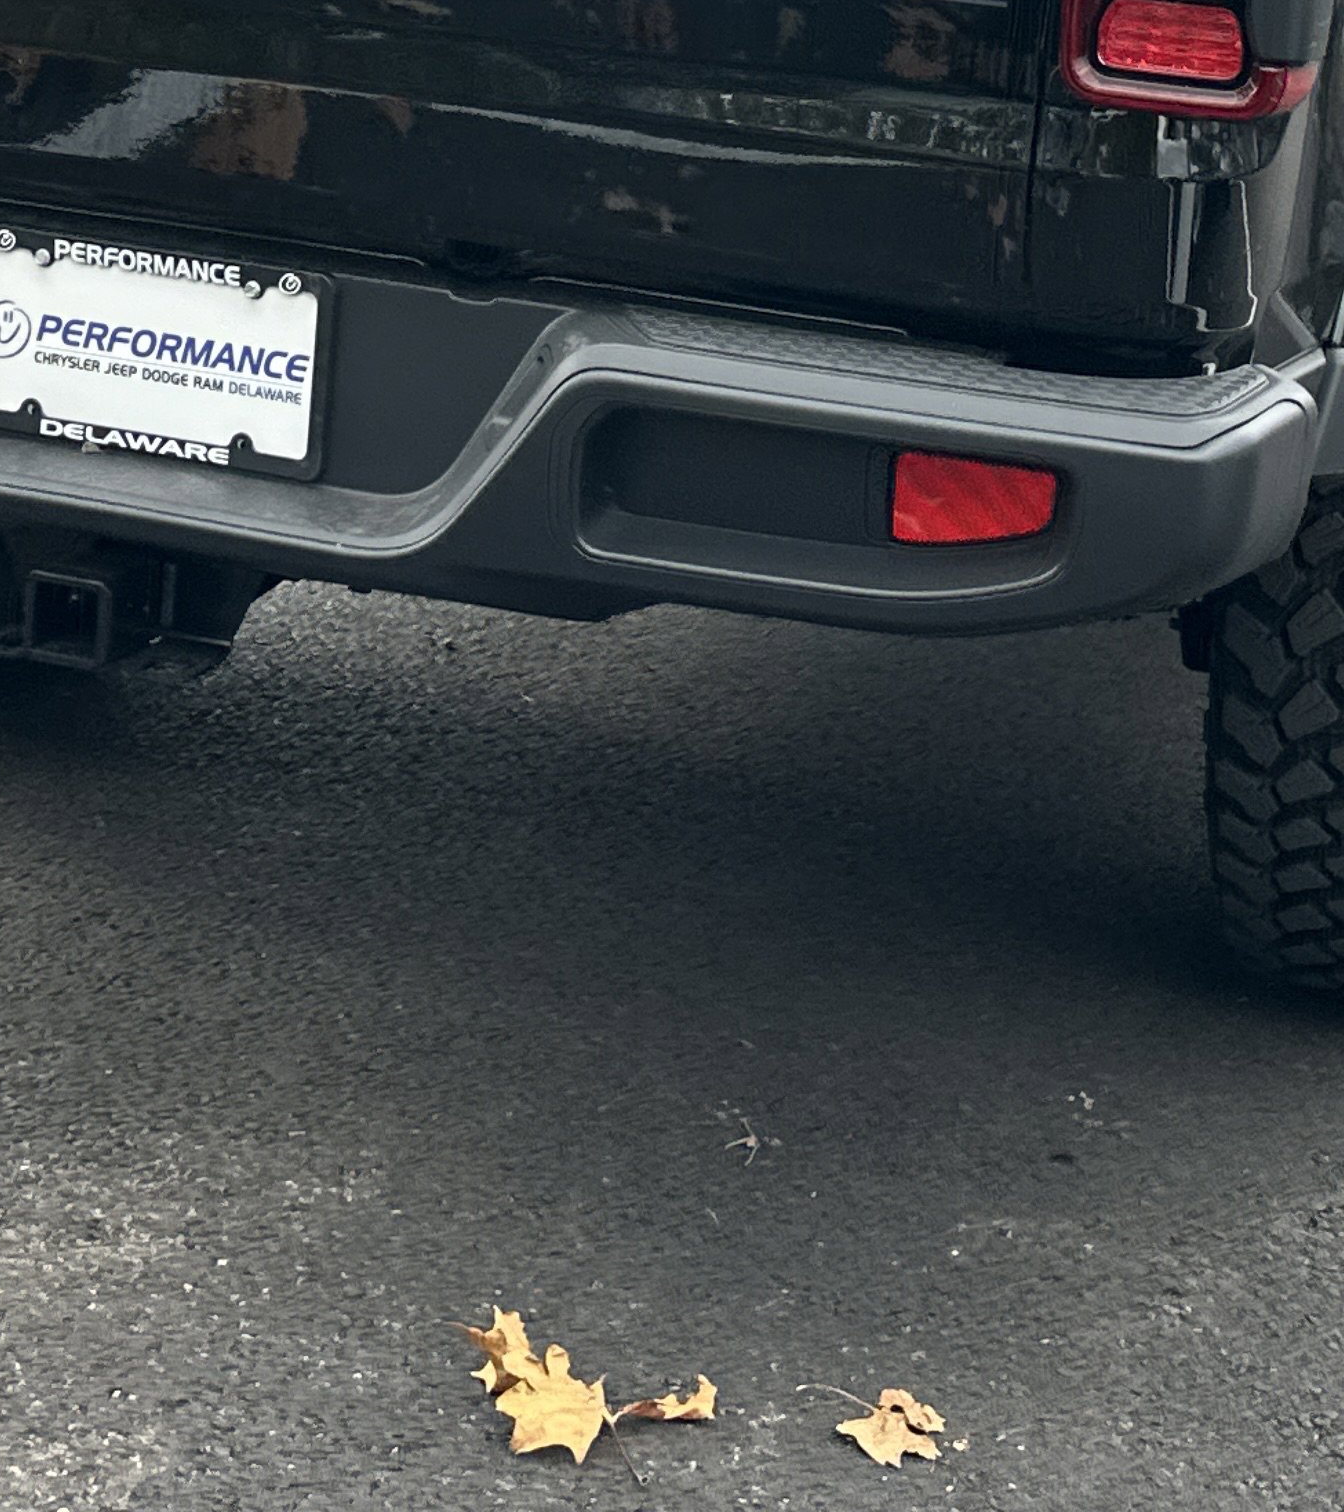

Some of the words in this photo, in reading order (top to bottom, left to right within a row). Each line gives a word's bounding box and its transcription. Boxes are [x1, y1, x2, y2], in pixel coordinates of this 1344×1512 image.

[53, 238, 242, 287] PERFORMANCE
[35, 313, 311, 383] PERFORMANCE
[33, 351, 101, 374] CHRYSLER
[104, 361, 138, 378] JEEP
[141, 367, 190, 387] DODGE
[192, 375, 224, 393] RAM
[227, 381, 303, 407] DELAWARE
[39, 418, 230, 466] DELAWARE
